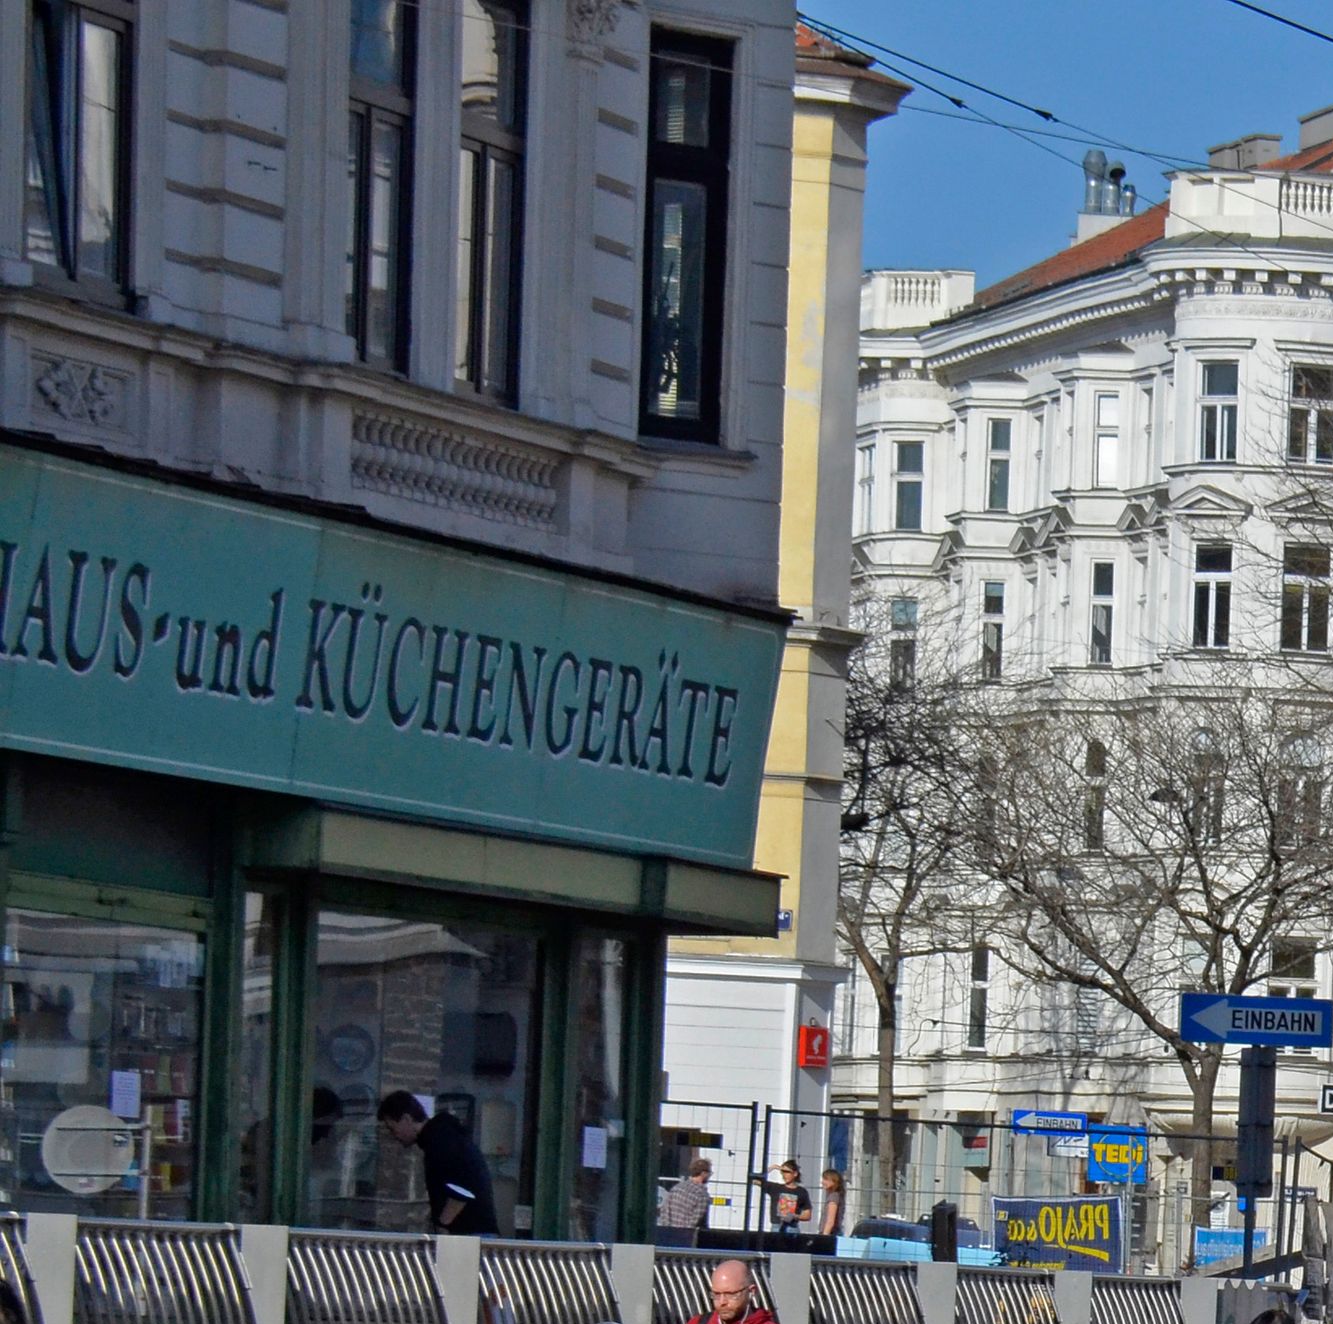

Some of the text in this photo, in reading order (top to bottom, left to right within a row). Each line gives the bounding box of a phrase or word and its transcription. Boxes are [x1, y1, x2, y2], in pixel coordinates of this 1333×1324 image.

[296, 581, 739, 790] KÜCHENGERÄTE
[1232, 1009, 1316, 1032] EINBAHN
[1036, 1117, 1079, 1130] EINBAHN
